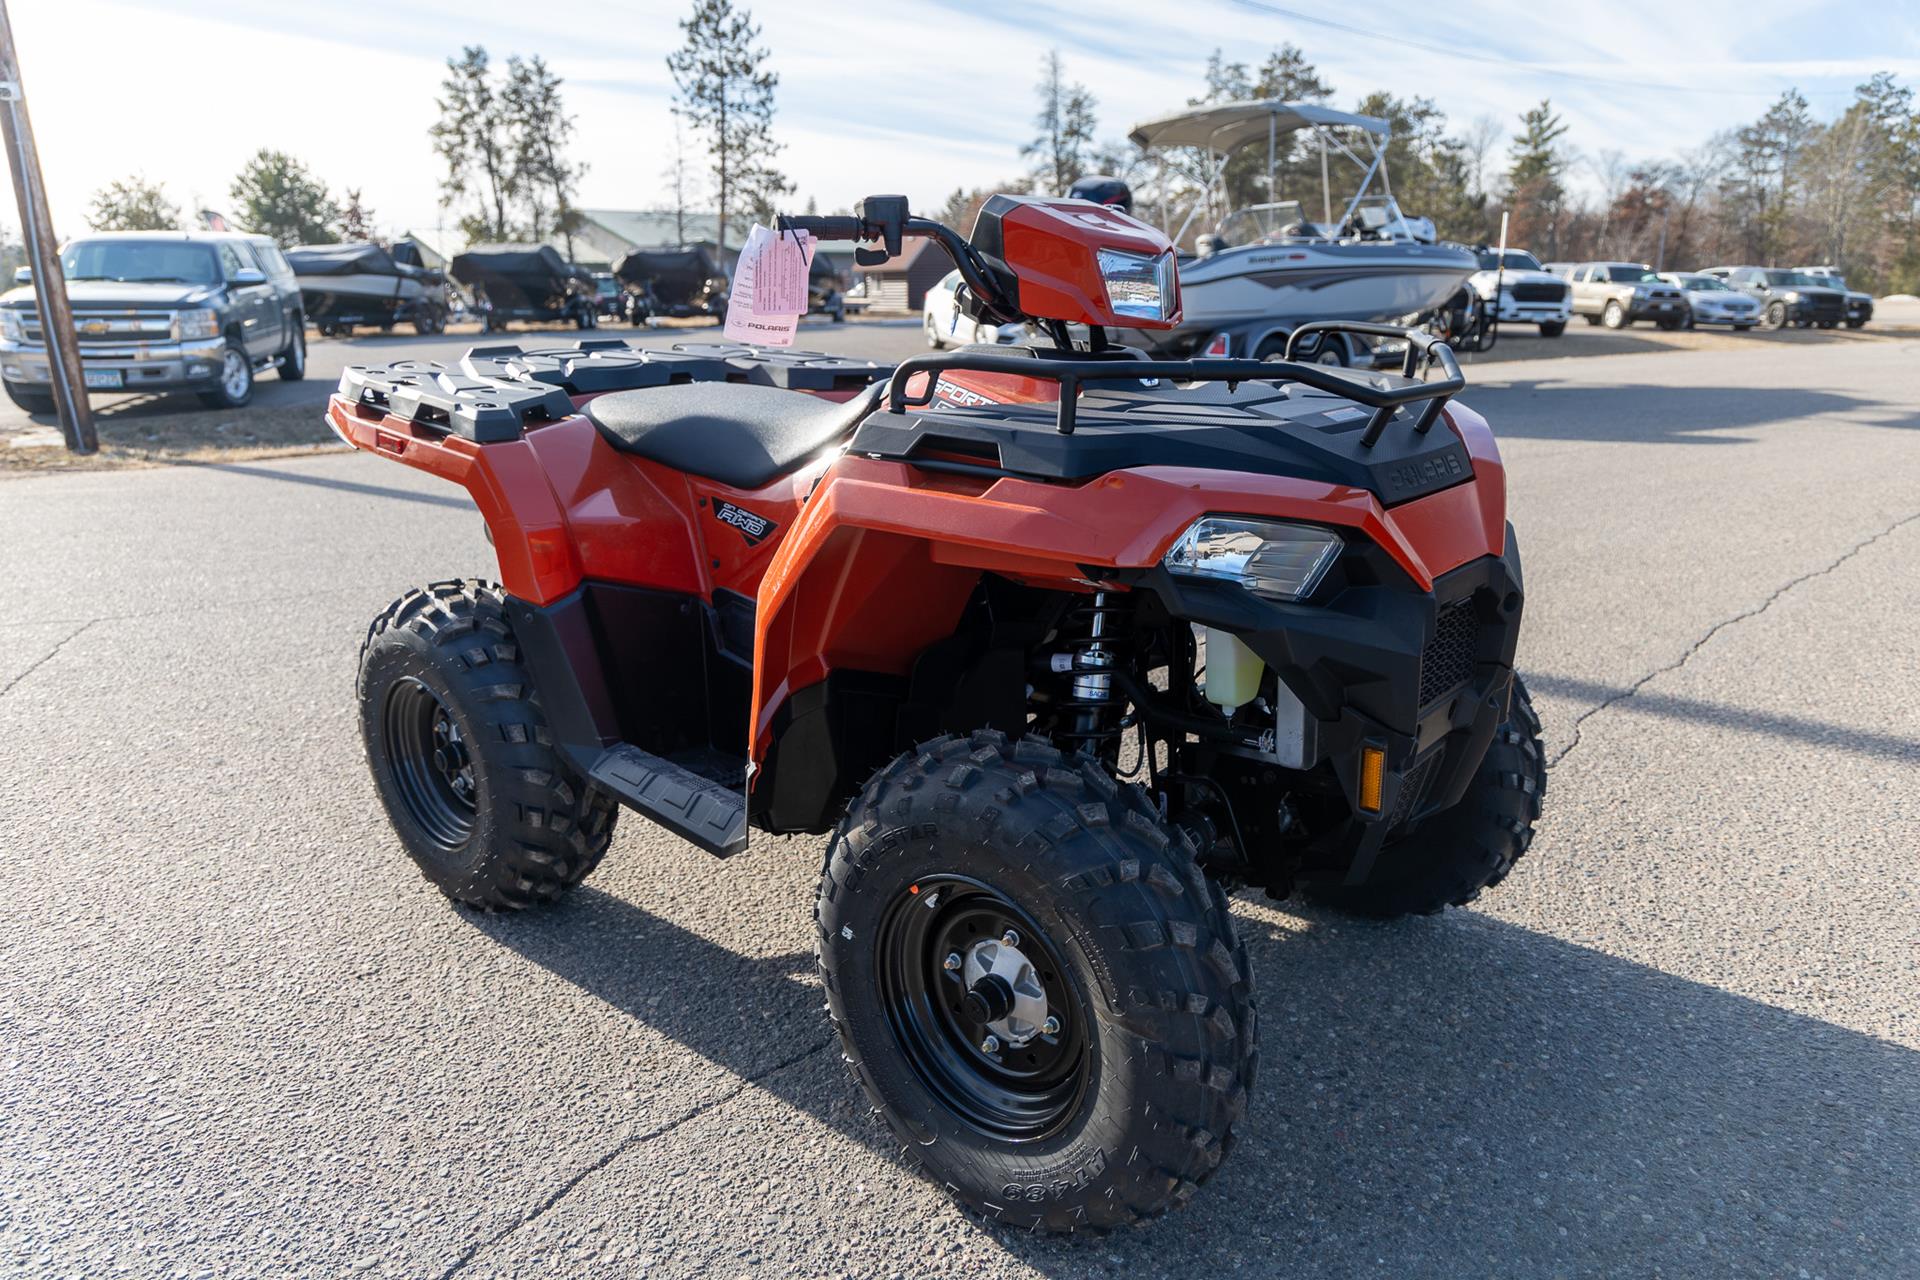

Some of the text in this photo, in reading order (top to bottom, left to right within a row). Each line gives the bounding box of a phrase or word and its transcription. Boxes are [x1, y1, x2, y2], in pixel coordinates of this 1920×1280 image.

[747, 321, 791, 333] POLARIS
[933, 378, 1000, 406] SPORT
[717, 508, 764, 535] AWD
